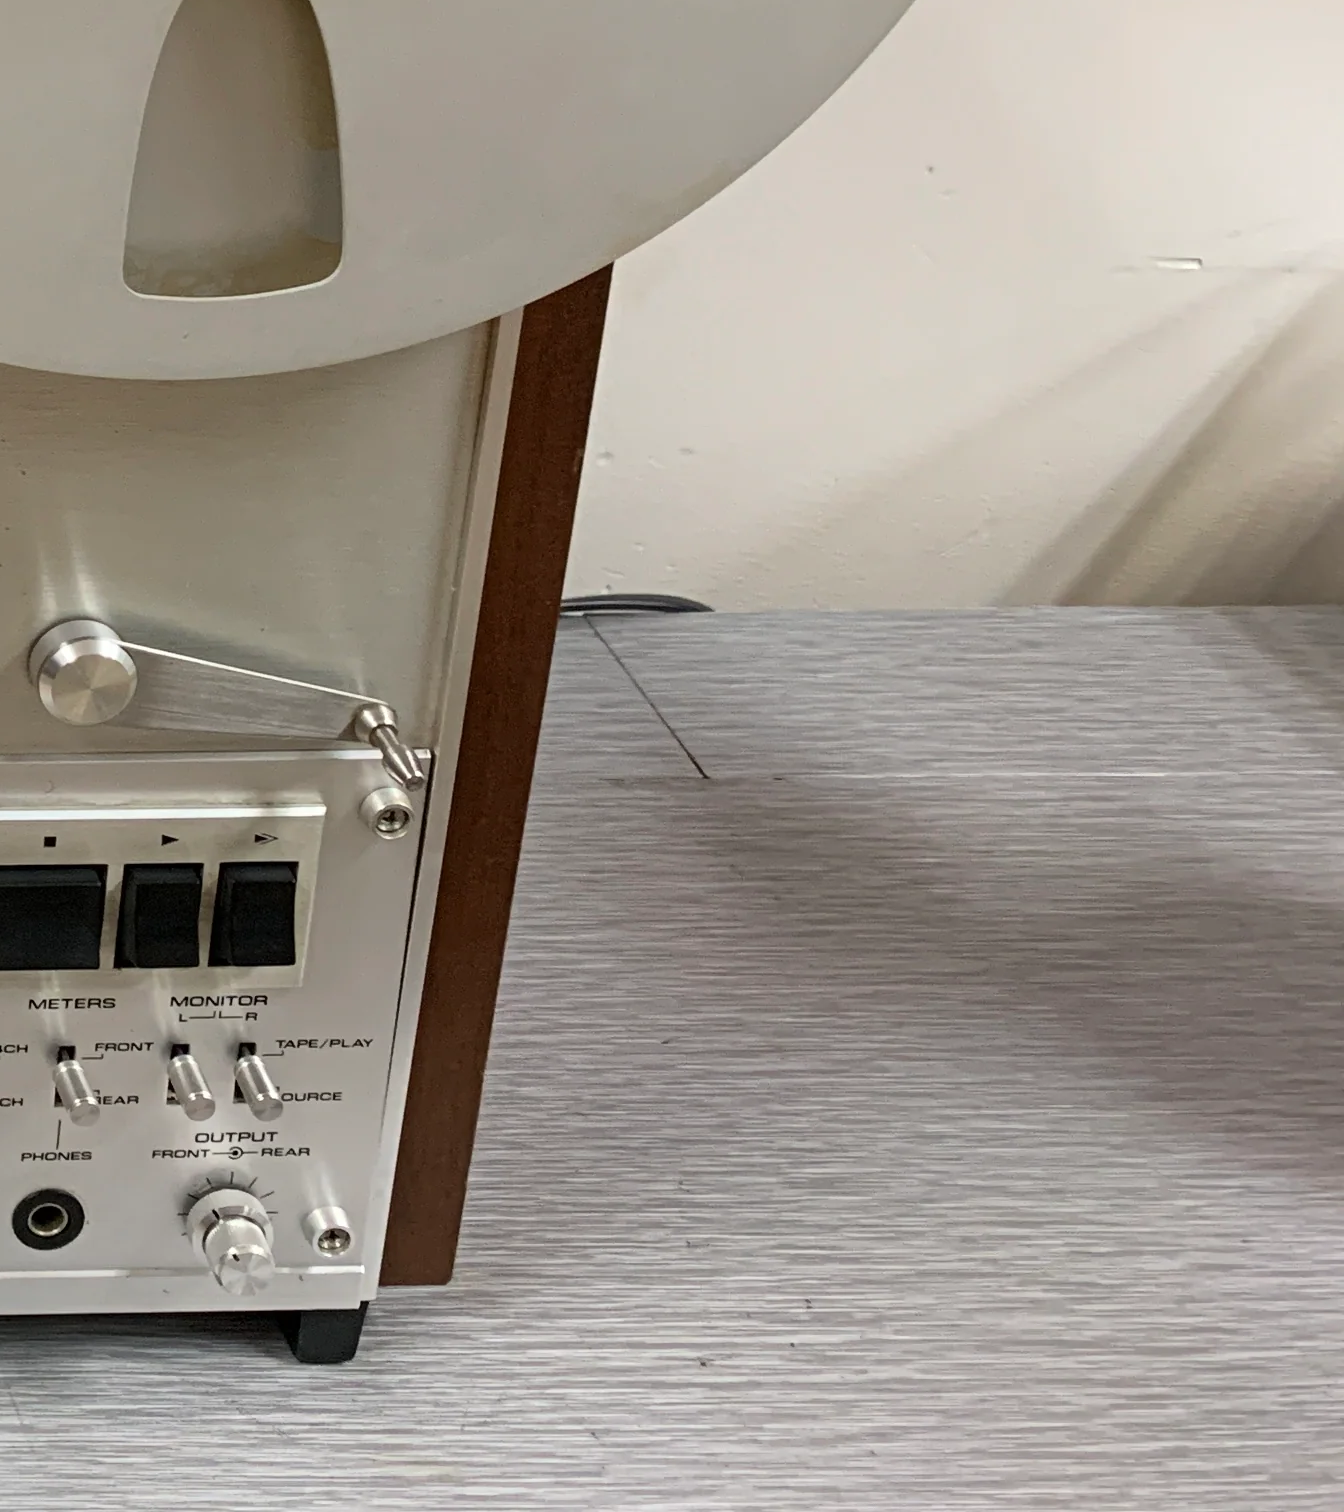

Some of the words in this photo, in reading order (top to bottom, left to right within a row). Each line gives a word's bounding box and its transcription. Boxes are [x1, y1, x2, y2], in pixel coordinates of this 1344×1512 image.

[28, 997, 117, 1010] METERS
[169, 994, 268, 1007] MONITOR
[179, 1013, 188, 1023] L
[245, 1011, 258, 1022] R
[94, 1041, 154, 1053] FRONT
[276, 1038, 374, 1049] TAPE/PLAY
[280, 1092, 343, 1102] OURCE
[195, 1131, 279, 1144] OUTPUT
[20, 1150, 92, 1162] PHONES
[152, 1148, 211, 1160] FRONT
[260, 1147, 311, 1157] REAR
